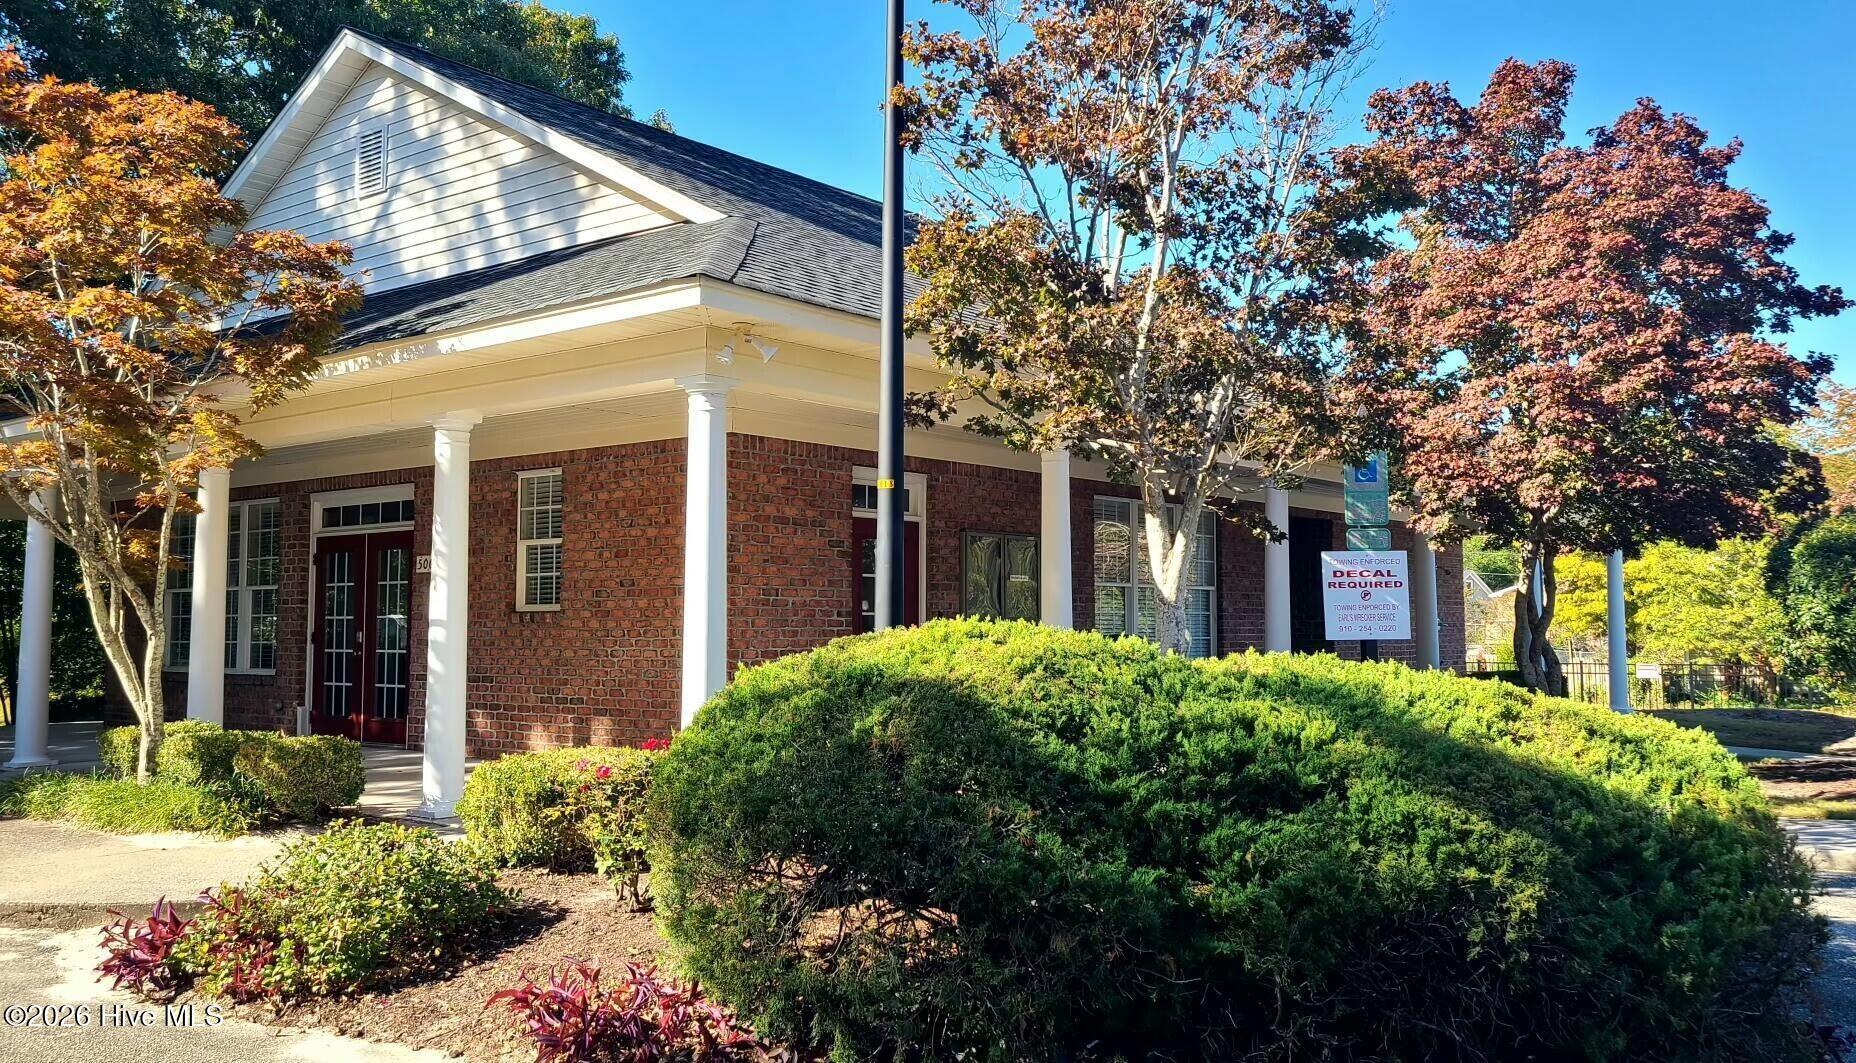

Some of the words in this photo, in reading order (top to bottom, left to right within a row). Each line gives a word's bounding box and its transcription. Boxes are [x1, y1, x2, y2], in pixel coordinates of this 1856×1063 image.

[1392, 602, 1400, 610] BY
[1376, 612, 1396, 622] SERVICE
[1378, 624, 1397, 632] 0220
